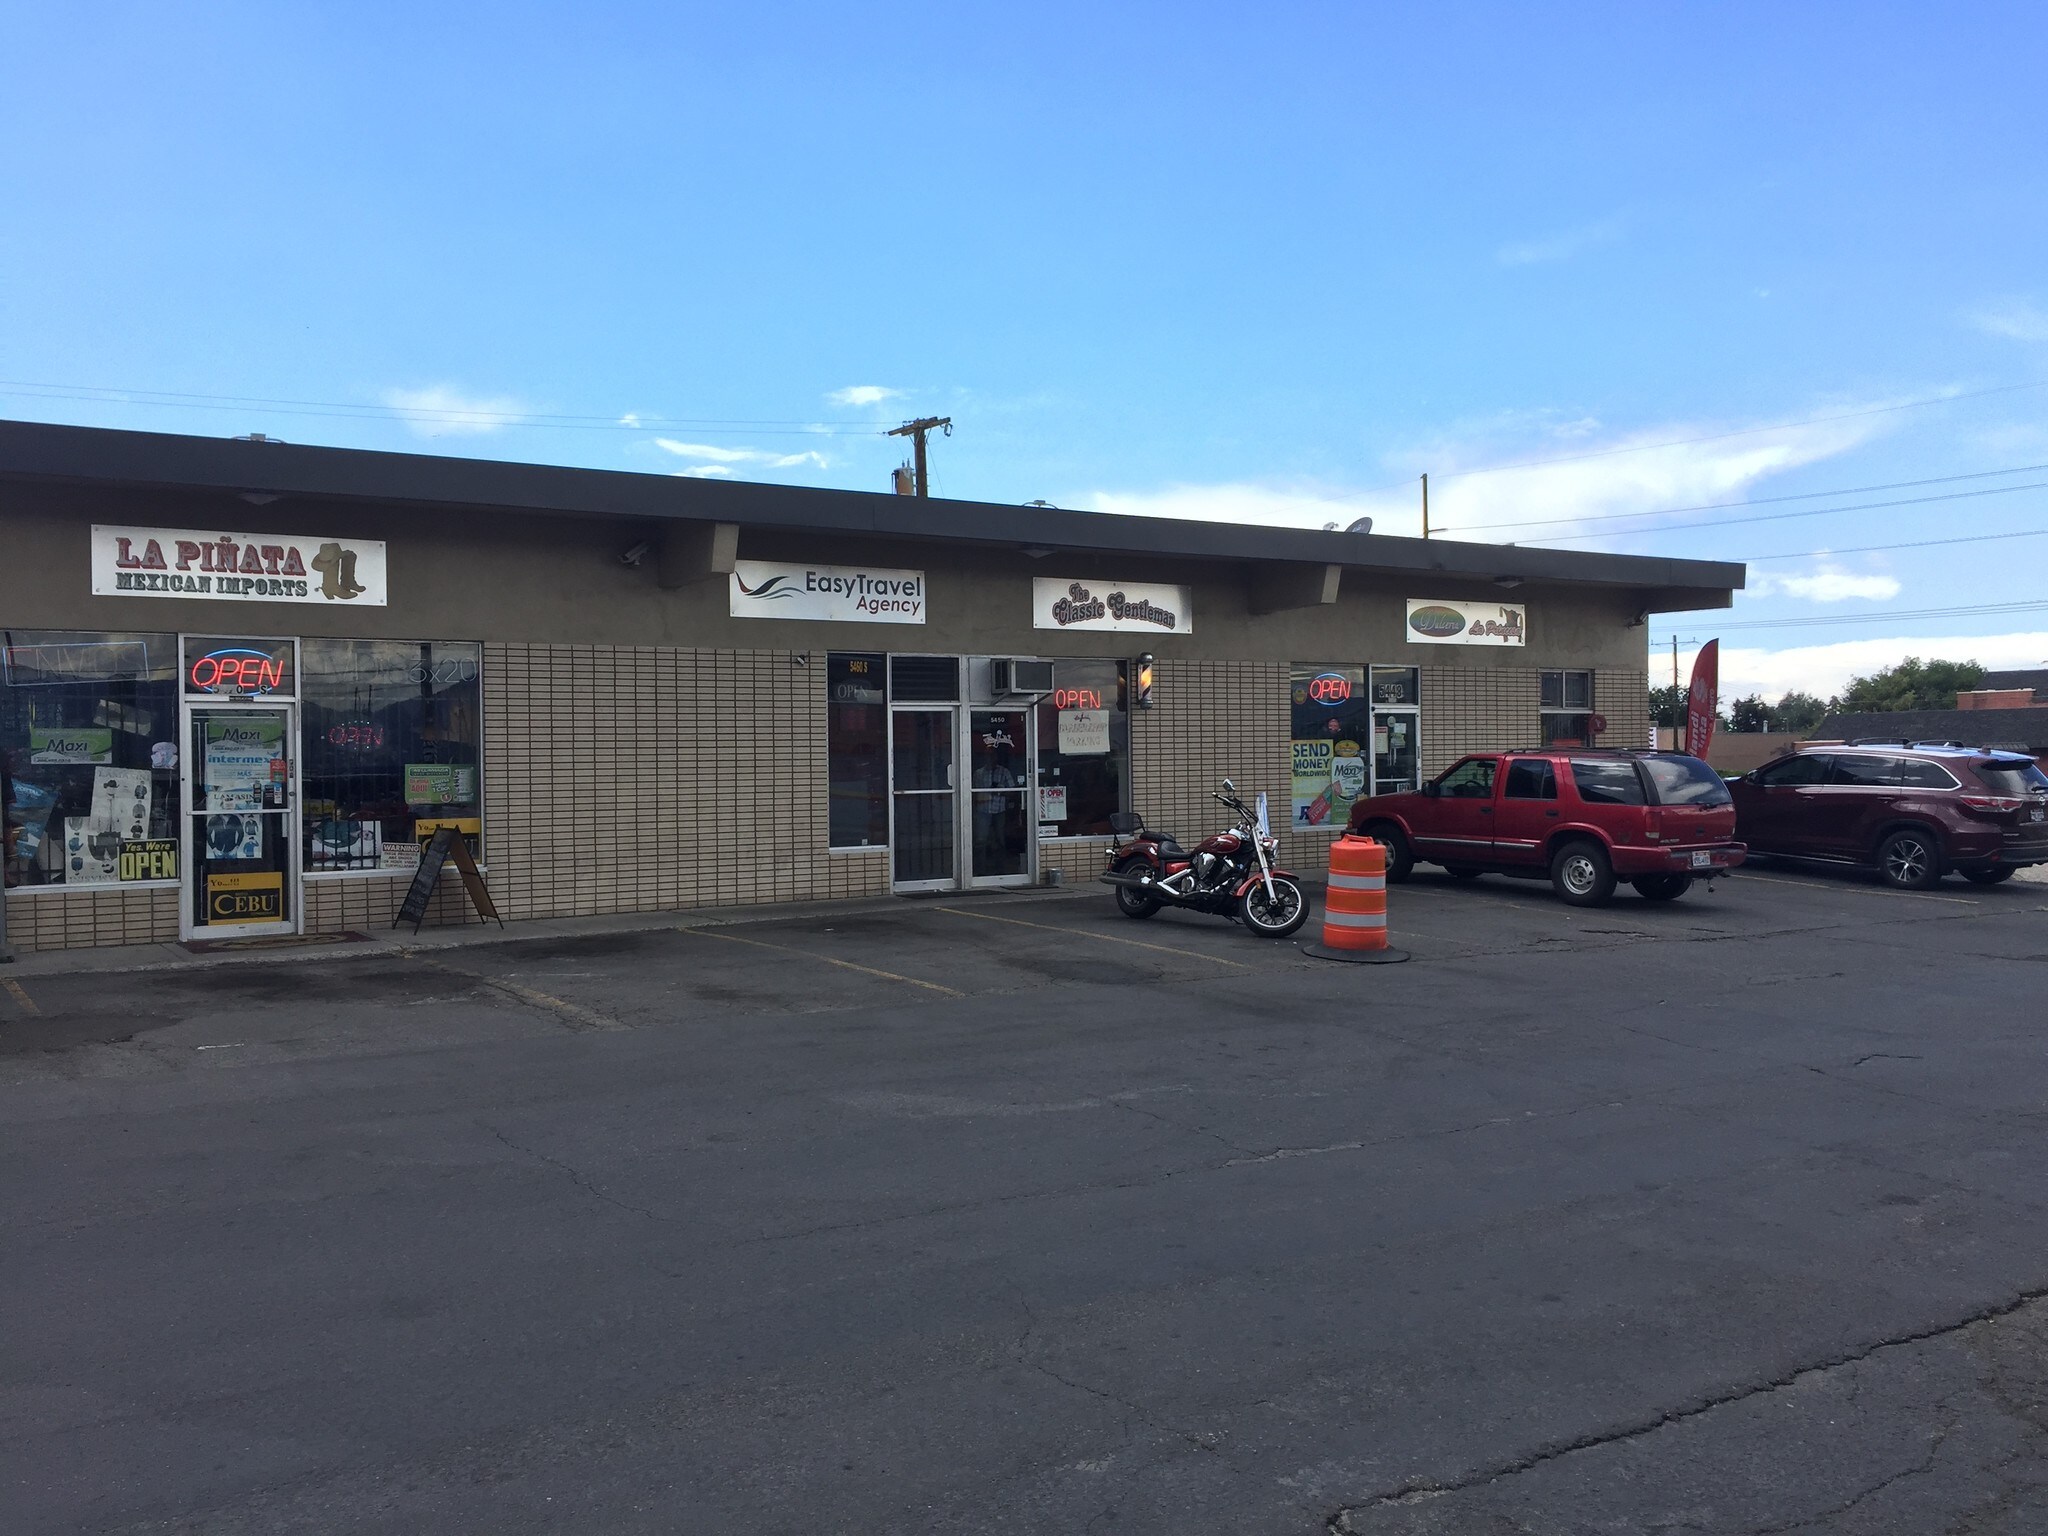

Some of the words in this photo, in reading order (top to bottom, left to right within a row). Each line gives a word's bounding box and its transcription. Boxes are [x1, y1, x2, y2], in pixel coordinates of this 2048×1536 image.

[115, 537, 167, 570] LA
[175, 536, 307, 576] PIÑATA
[115, 572, 211, 593] MEXICAN
[216, 576, 308, 597] IMPORTS
[806, 571, 921, 598] EasyTravel
[1069, 583, 1090, 603] The
[856, 596, 921, 615] Agency
[1052, 596, 1105, 626] Classic
[1107, 591, 1175, 630] Gentleman
[192, 657, 284, 688] OPEN
[1055, 689, 1101, 709] OPEN
[1310, 679, 1351, 700] OPEN
[223, 728, 261, 741] Maxi
[46, 739, 88, 752] Maxi
[1293, 743, 1330, 757] SEND
[207, 754, 270, 764] intermex
[1293, 759, 1330, 769] MONEY
[383, 844, 419, 852] WARNING
[121, 850, 177, 880] OPEN
[214, 894, 275, 915] CEBU
